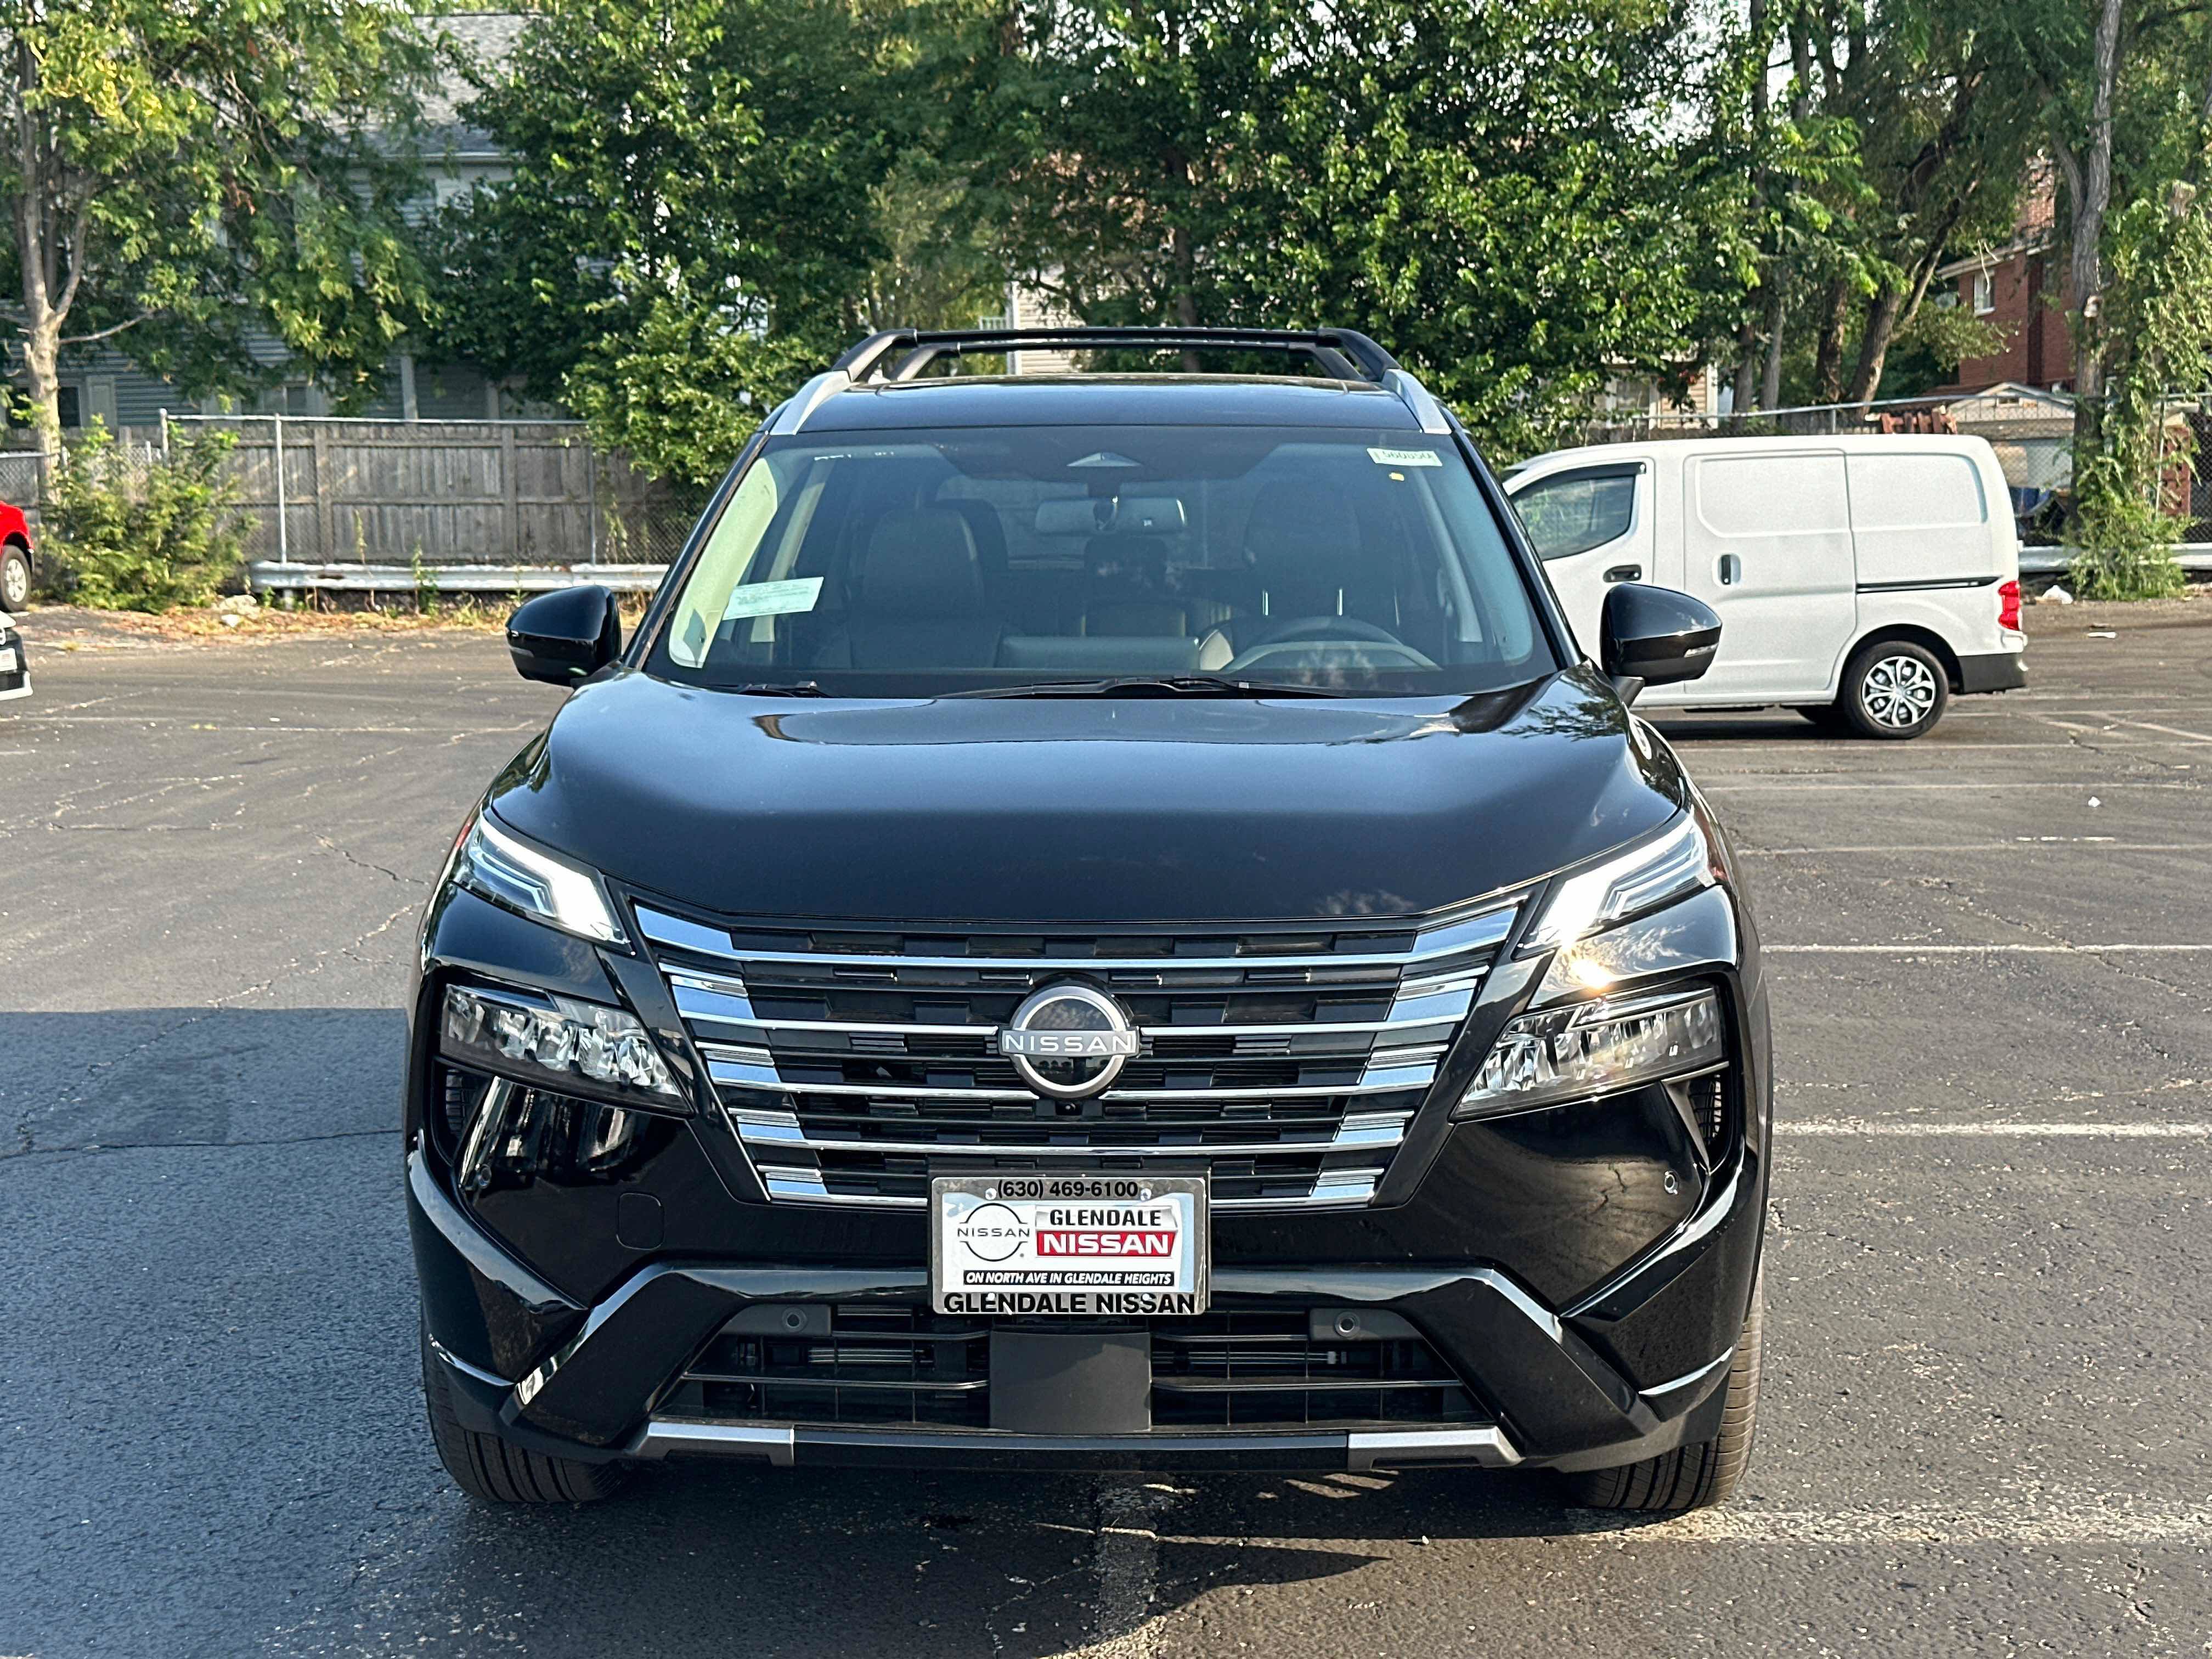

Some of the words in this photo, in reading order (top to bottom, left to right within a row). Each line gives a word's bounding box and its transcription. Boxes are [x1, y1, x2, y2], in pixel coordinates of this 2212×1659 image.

[1005, 1035, 1132, 1052] NISSAN
[998, 1180, 1044, 1198] (630)
[1050, 1182, 1138, 1197] 469-6100
[1050, 1210, 1161, 1226] GLENDALE
[957, 1228, 1030, 1237] NISSAN
[1043, 1234, 1169, 1254] NISSAN
[967, 1273, 984, 1283] ON
[985, 1273, 1024, 1284] NORTH
[1025, 1273, 1048, 1284] AVE
[1049, 1273, 1063, 1284] IN
[1064, 1273, 1122, 1284] GLENDALE
[1124, 1273, 1171, 1284] HEIGHTS
[944, 1293, 1087, 1313] GLENDALE
[1097, 1294, 1195, 1313] NISSAN
